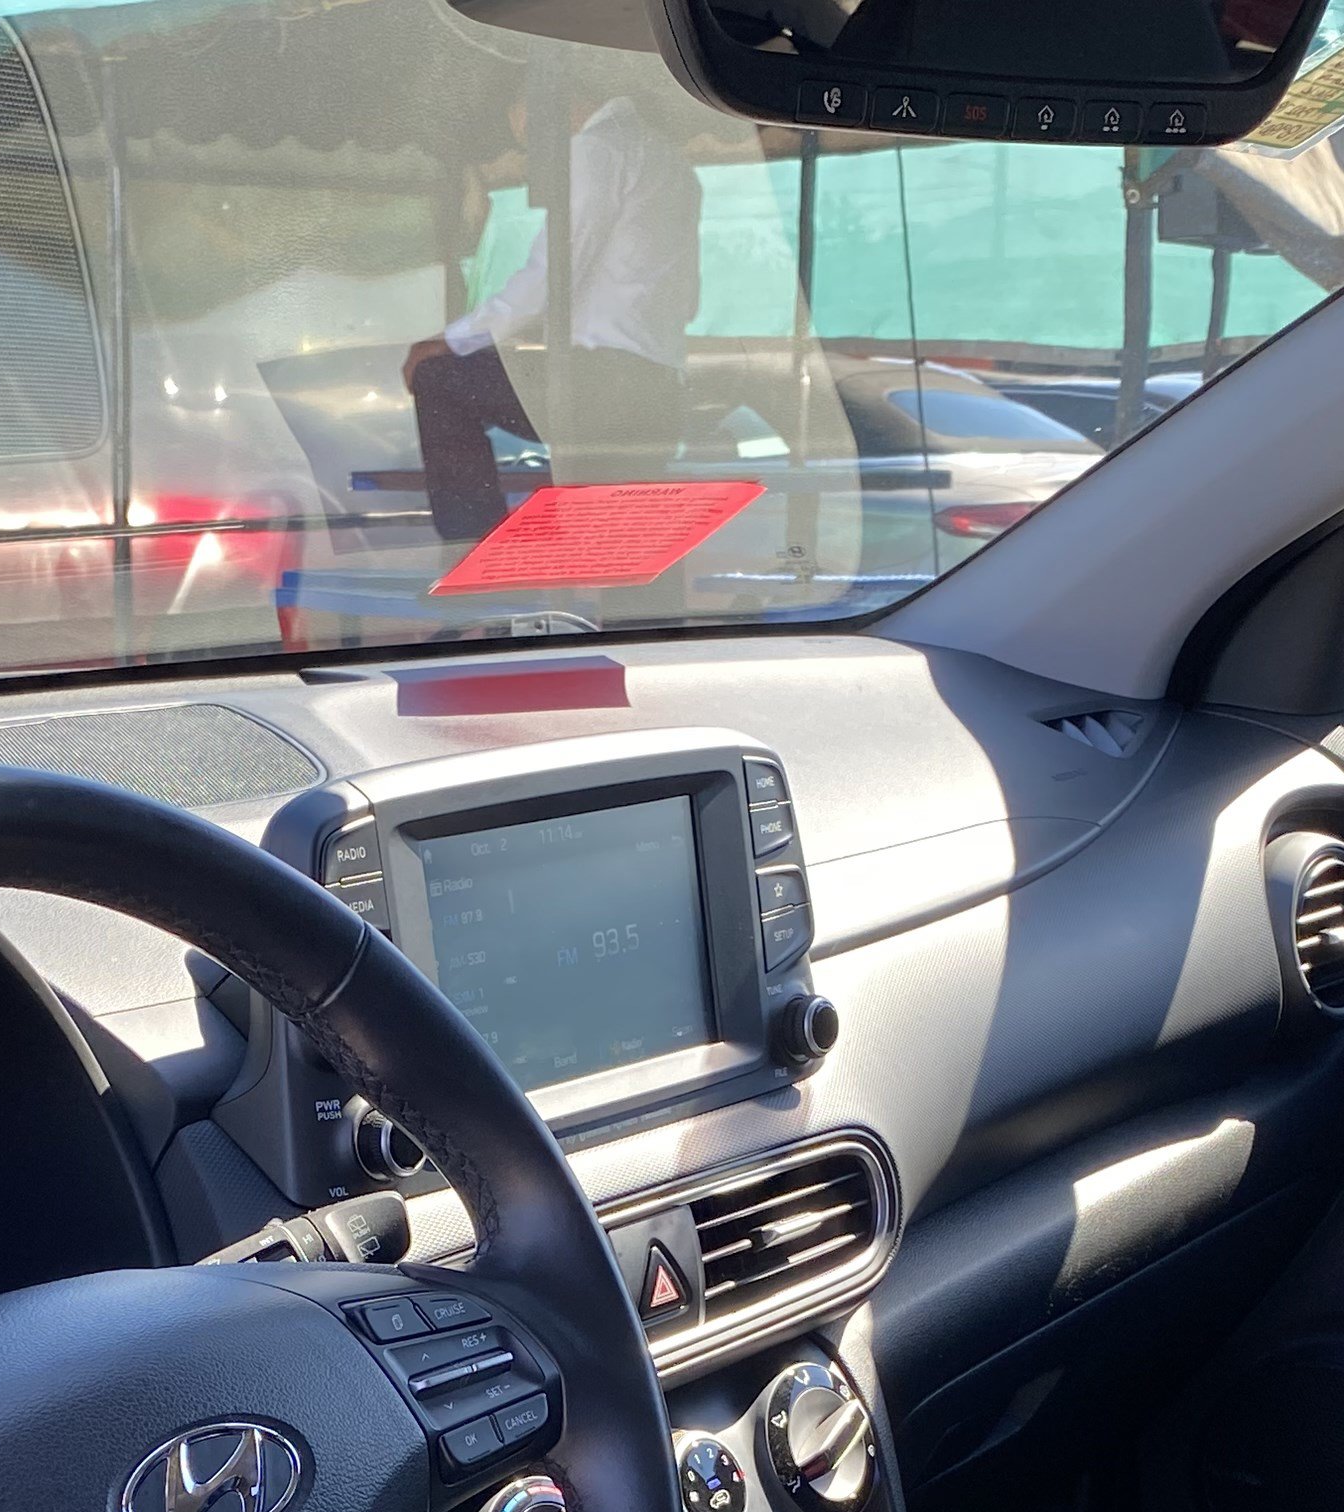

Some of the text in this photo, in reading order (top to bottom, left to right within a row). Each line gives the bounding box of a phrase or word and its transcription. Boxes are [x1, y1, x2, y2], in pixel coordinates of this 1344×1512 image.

[964, 105, 987, 121] SOS
[756, 775, 775, 787] HOME
[760, 820, 783, 834] PHONE
[337, 846, 367, 863] RADIO
[443, 877, 473, 893] Radio
[773, 927, 795, 942] SETUP
[557, 923, 640, 967] FM 93.5
[767, 984, 783, 997] TUNE
[315, 1099, 341, 1112] PWR
[317, 1110, 342, 1121] PUSH
[329, 1187, 349, 1198] VOL
[433, 1302, 466, 1321] CRUISE
[504, 1410, 538, 1431] CANCEL
[464, 1433, 479, 1447] OK
[693, 1453, 701, 1465] 1
[706, 1447, 715, 1459] 2
[720, 1454, 730, 1466] 3
